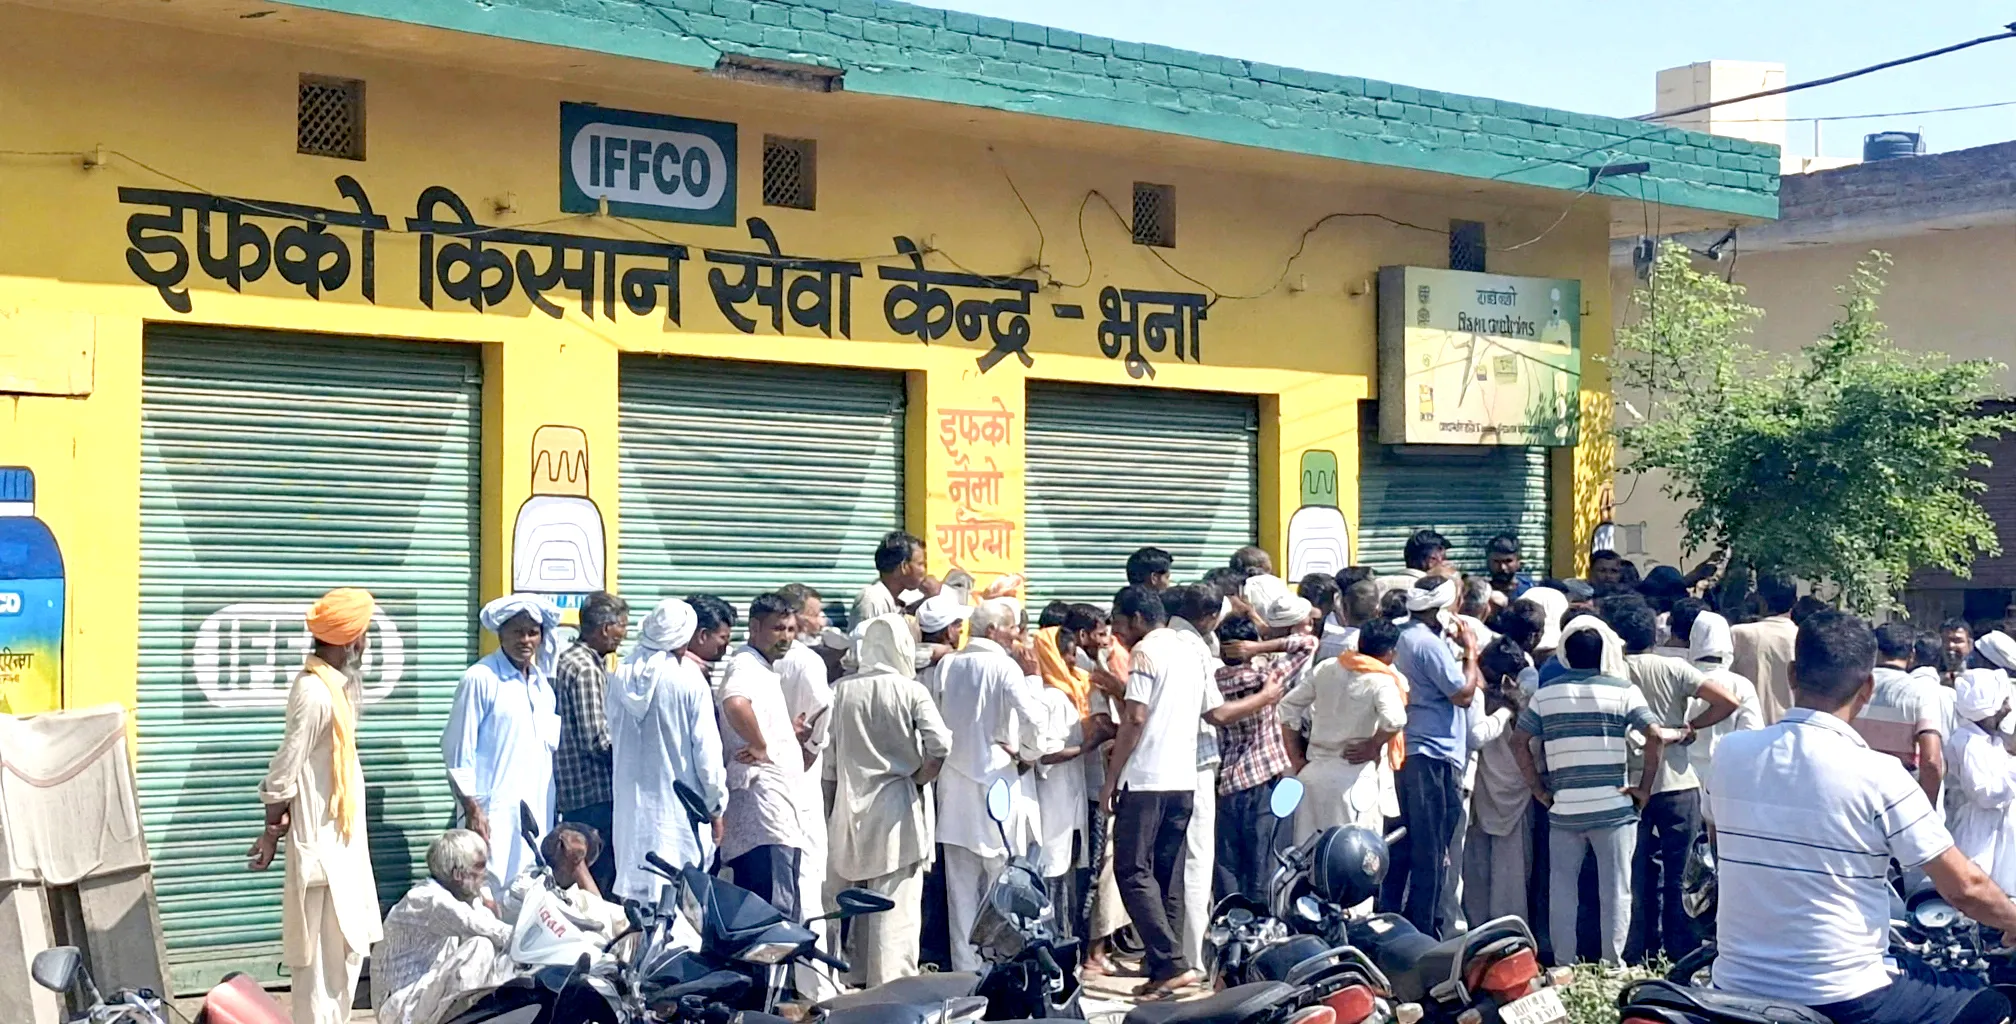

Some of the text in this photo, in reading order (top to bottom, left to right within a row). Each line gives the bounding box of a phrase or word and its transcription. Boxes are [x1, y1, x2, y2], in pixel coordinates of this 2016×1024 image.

[590, 134, 712, 199] IFFCO
[118, 175, 390, 313] इफको
[405, 186, 690, 328] किसान
[703, 217, 863, 340] सेवा
[878, 236, 1039, 374] केन्द्र
[1097, 286, 1208, 380] भूना
[937, 396, 1015, 457] इफको
